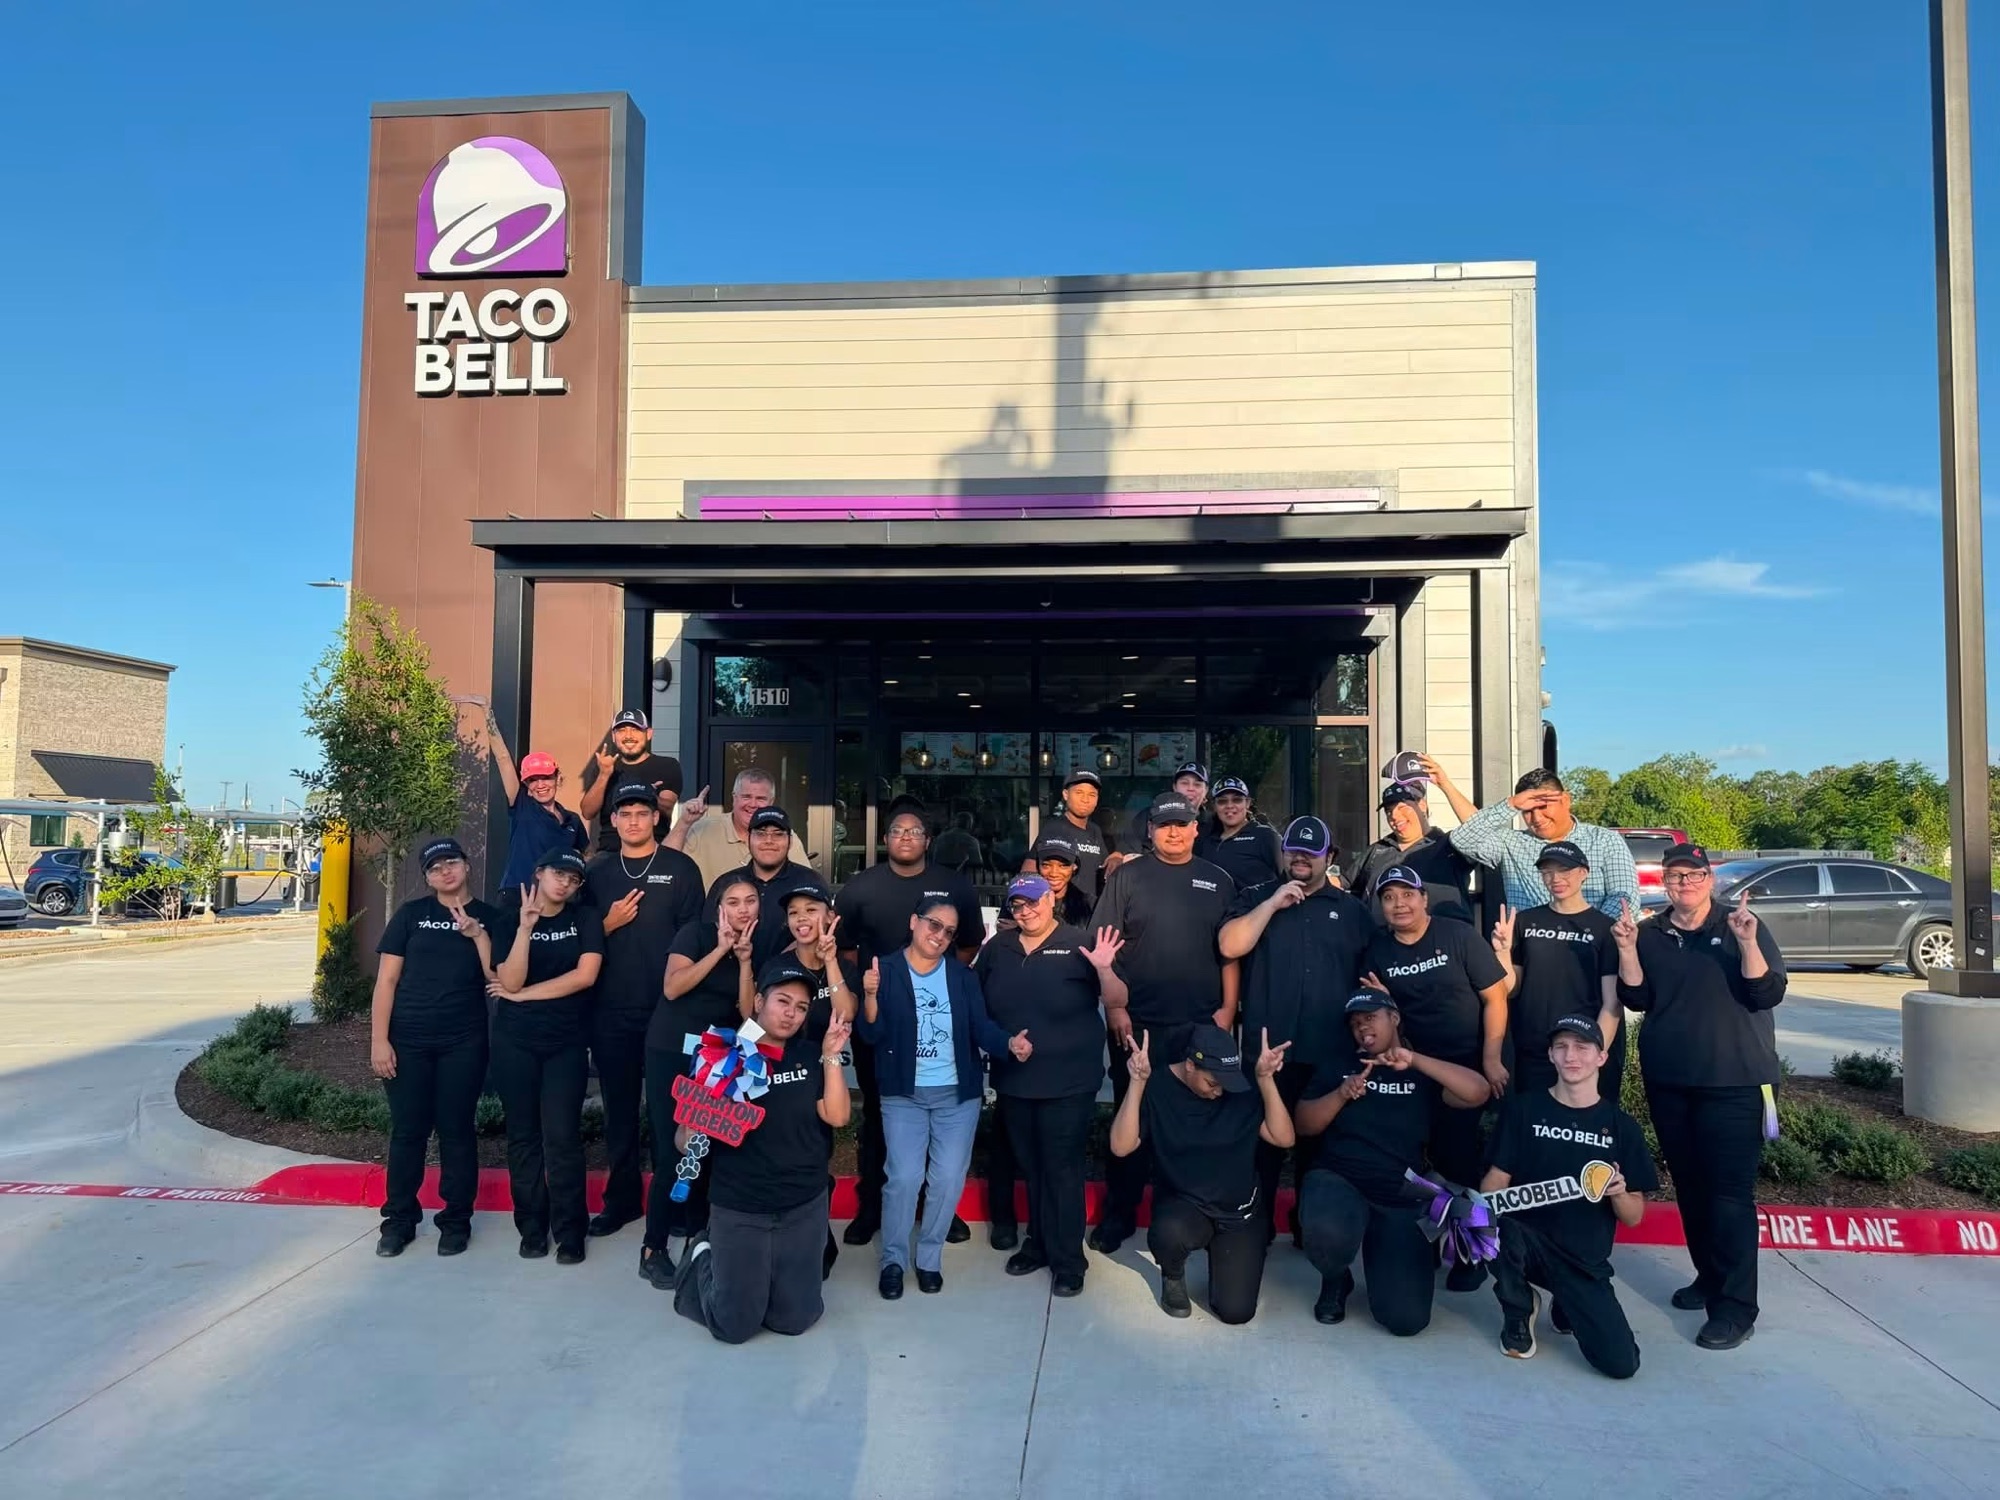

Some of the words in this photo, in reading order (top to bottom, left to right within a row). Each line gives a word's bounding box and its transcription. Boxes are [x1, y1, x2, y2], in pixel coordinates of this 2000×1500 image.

[404, 287, 568, 340] TACO
[414, 342, 565, 393] BELL
[751, 688, 788, 704] 1510
[418, 920, 451, 930] TACO
[530, 932, 550, 941] CO
[1524, 927, 1557, 940] TACO
[1386, 962, 1420, 977] TACO
[916, 1046, 938, 1058] itch
[680, 1102, 742, 1141] TIGERS
[1532, 1124, 1573, 1141] TACO
[119, 1186, 160, 1198] NO
[158, 1188, 265, 1202] PARKING
[1484, 1178, 1581, 1214] TACOBELL
[1757, 1213, 1818, 1246] FIRE
[1825, 1215, 1905, 1249] LANE
[1956, 1219, 1998, 1251] NO
